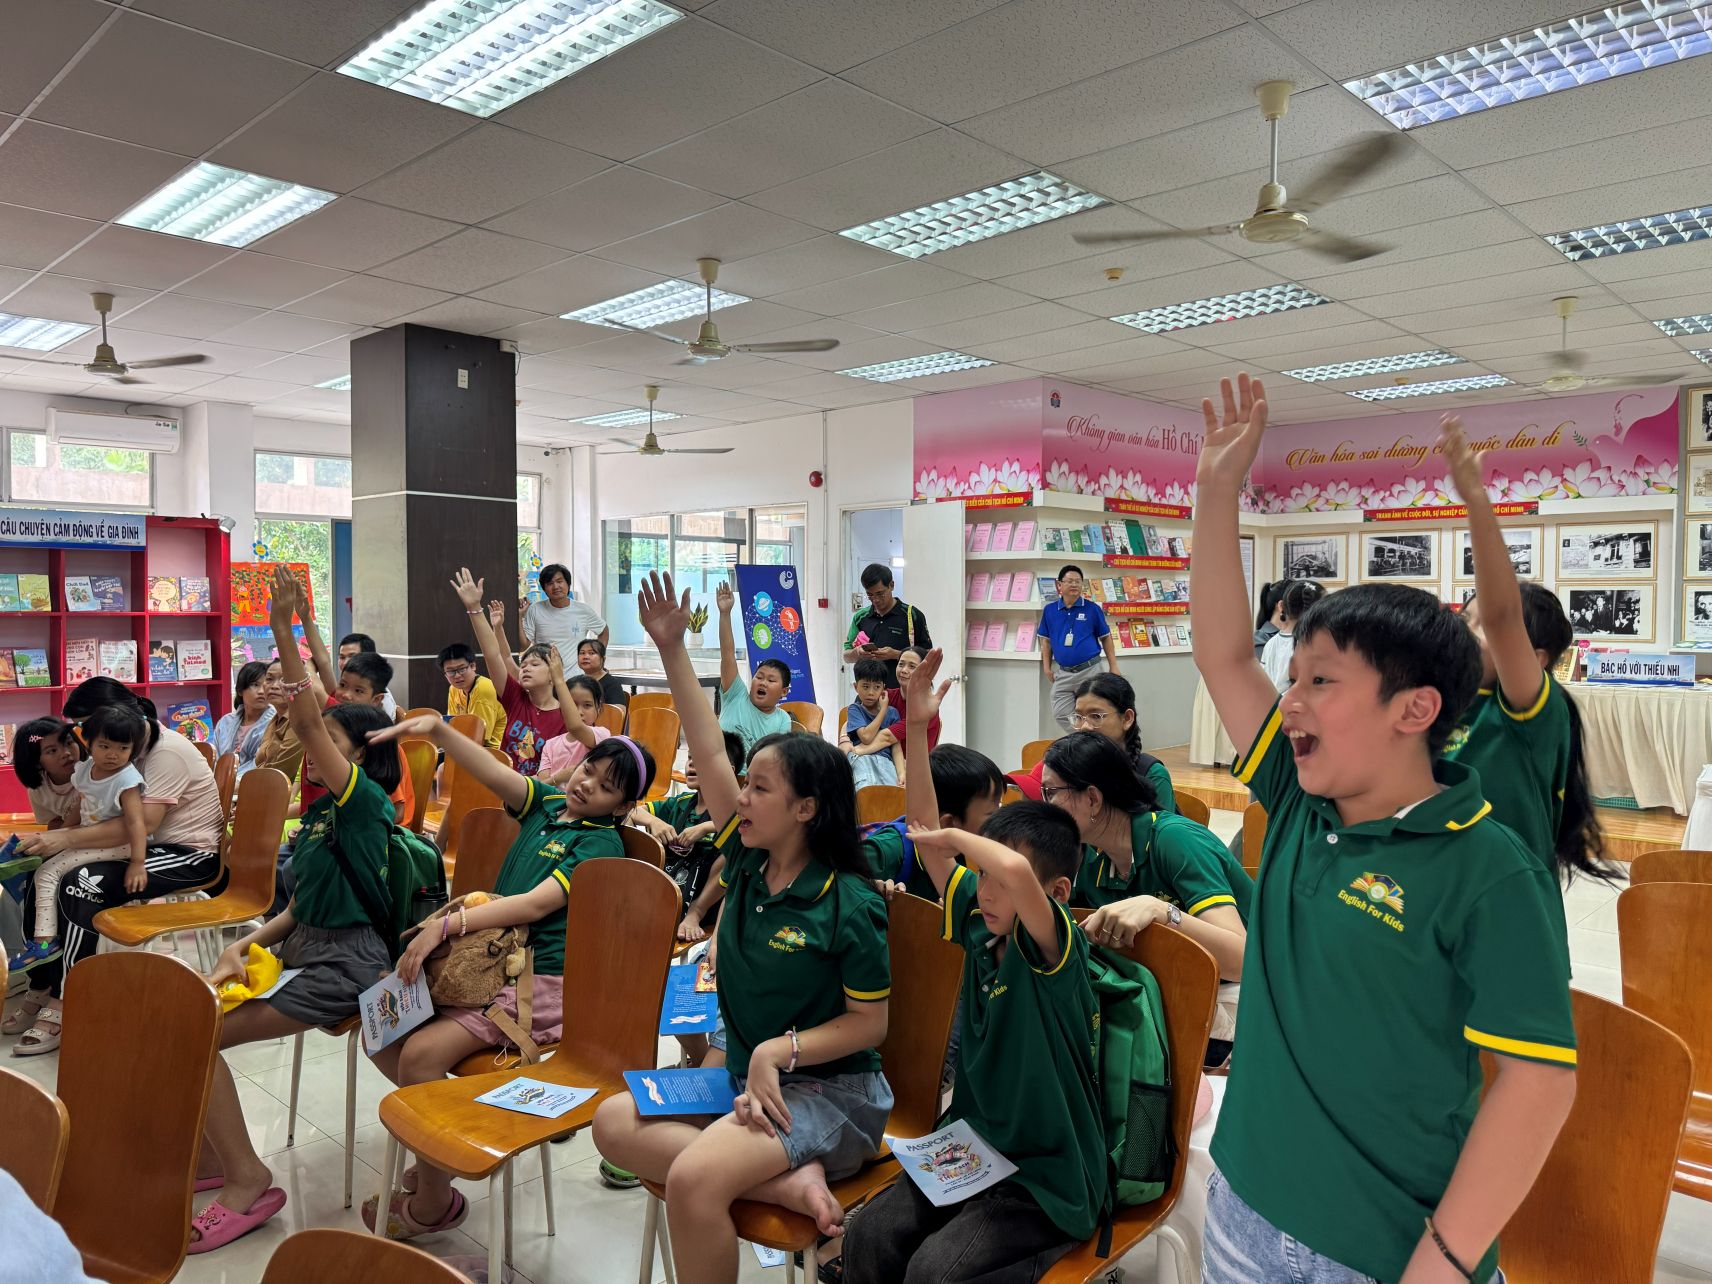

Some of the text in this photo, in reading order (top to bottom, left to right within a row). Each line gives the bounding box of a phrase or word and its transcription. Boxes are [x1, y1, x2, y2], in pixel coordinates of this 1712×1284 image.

[1066, 413, 1106, 452] Không
[1100, 428, 1125, 453] gian
[1162, 424, 1177, 452] Hồ
[1180, 431, 1199, 456] Chí
[1285, 447, 1327, 472] Văn
[1330, 440, 1356, 463] hóa
[1359, 446, 1381, 460] soi
[1392, 510, 1401, 518] ẢNH
[1401, 509, 1408, 518] VỀ
[1409, 510, 1421, 519] CUỘC
[1432, 509, 1439, 518] SỰ
[1440, 508, 1458, 517] NGHIỆP
[1501, 505, 1510, 514] CHÍ
[0, 517, 139, 541] CÂU CHUYỆN CẢM ĐỘNG VỀ GIA ĐÌNH
[1601, 658, 1680, 677] BÁC HỒ VỚI THIẾU NHI
[1337, 889, 1405, 932] English For Kids
[366, 1002, 378, 1040] PASSPORT
[906, 1131, 955, 1152] PASSPORT
